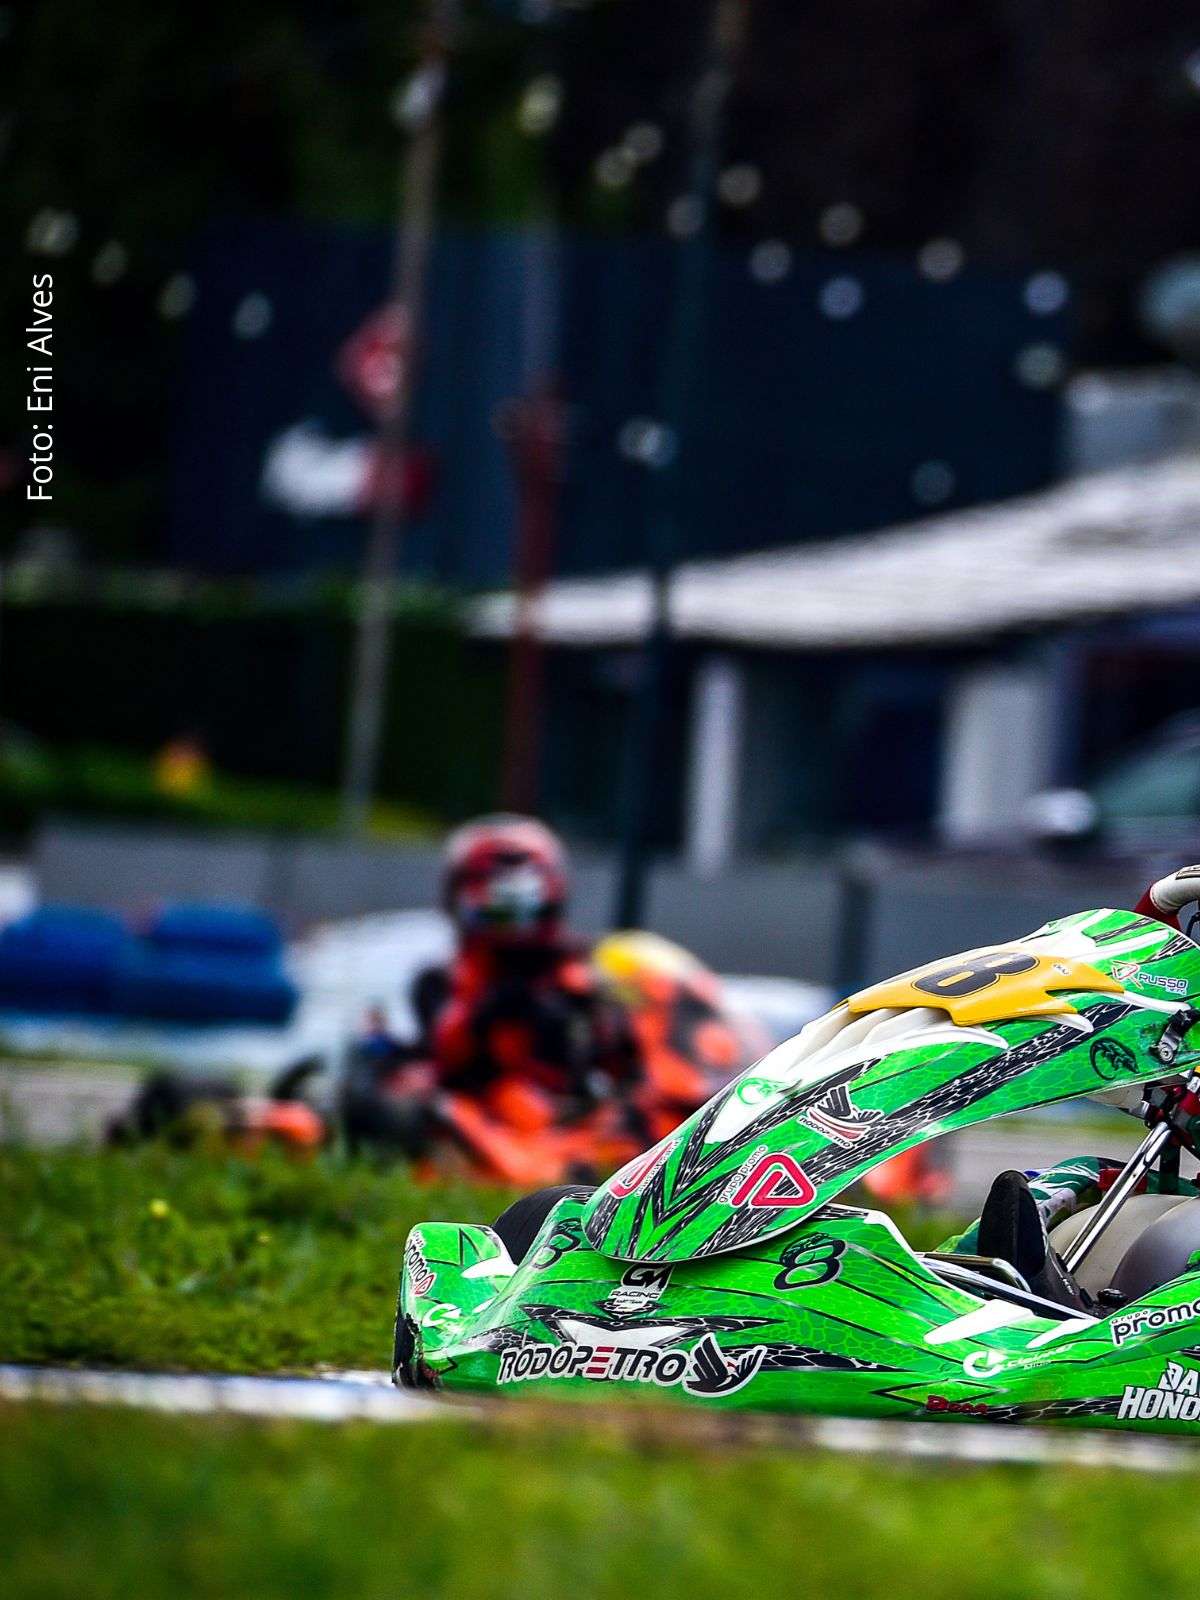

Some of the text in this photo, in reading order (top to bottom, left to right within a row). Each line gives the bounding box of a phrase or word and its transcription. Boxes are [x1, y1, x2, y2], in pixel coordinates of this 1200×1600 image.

[1137, 972, 1188, 990] RUSSO
[610, 1290, 660, 1299] RACING
[1112, 1298, 1200, 1345] promo
[498, 1344, 688, 1384] RODOPETRO
